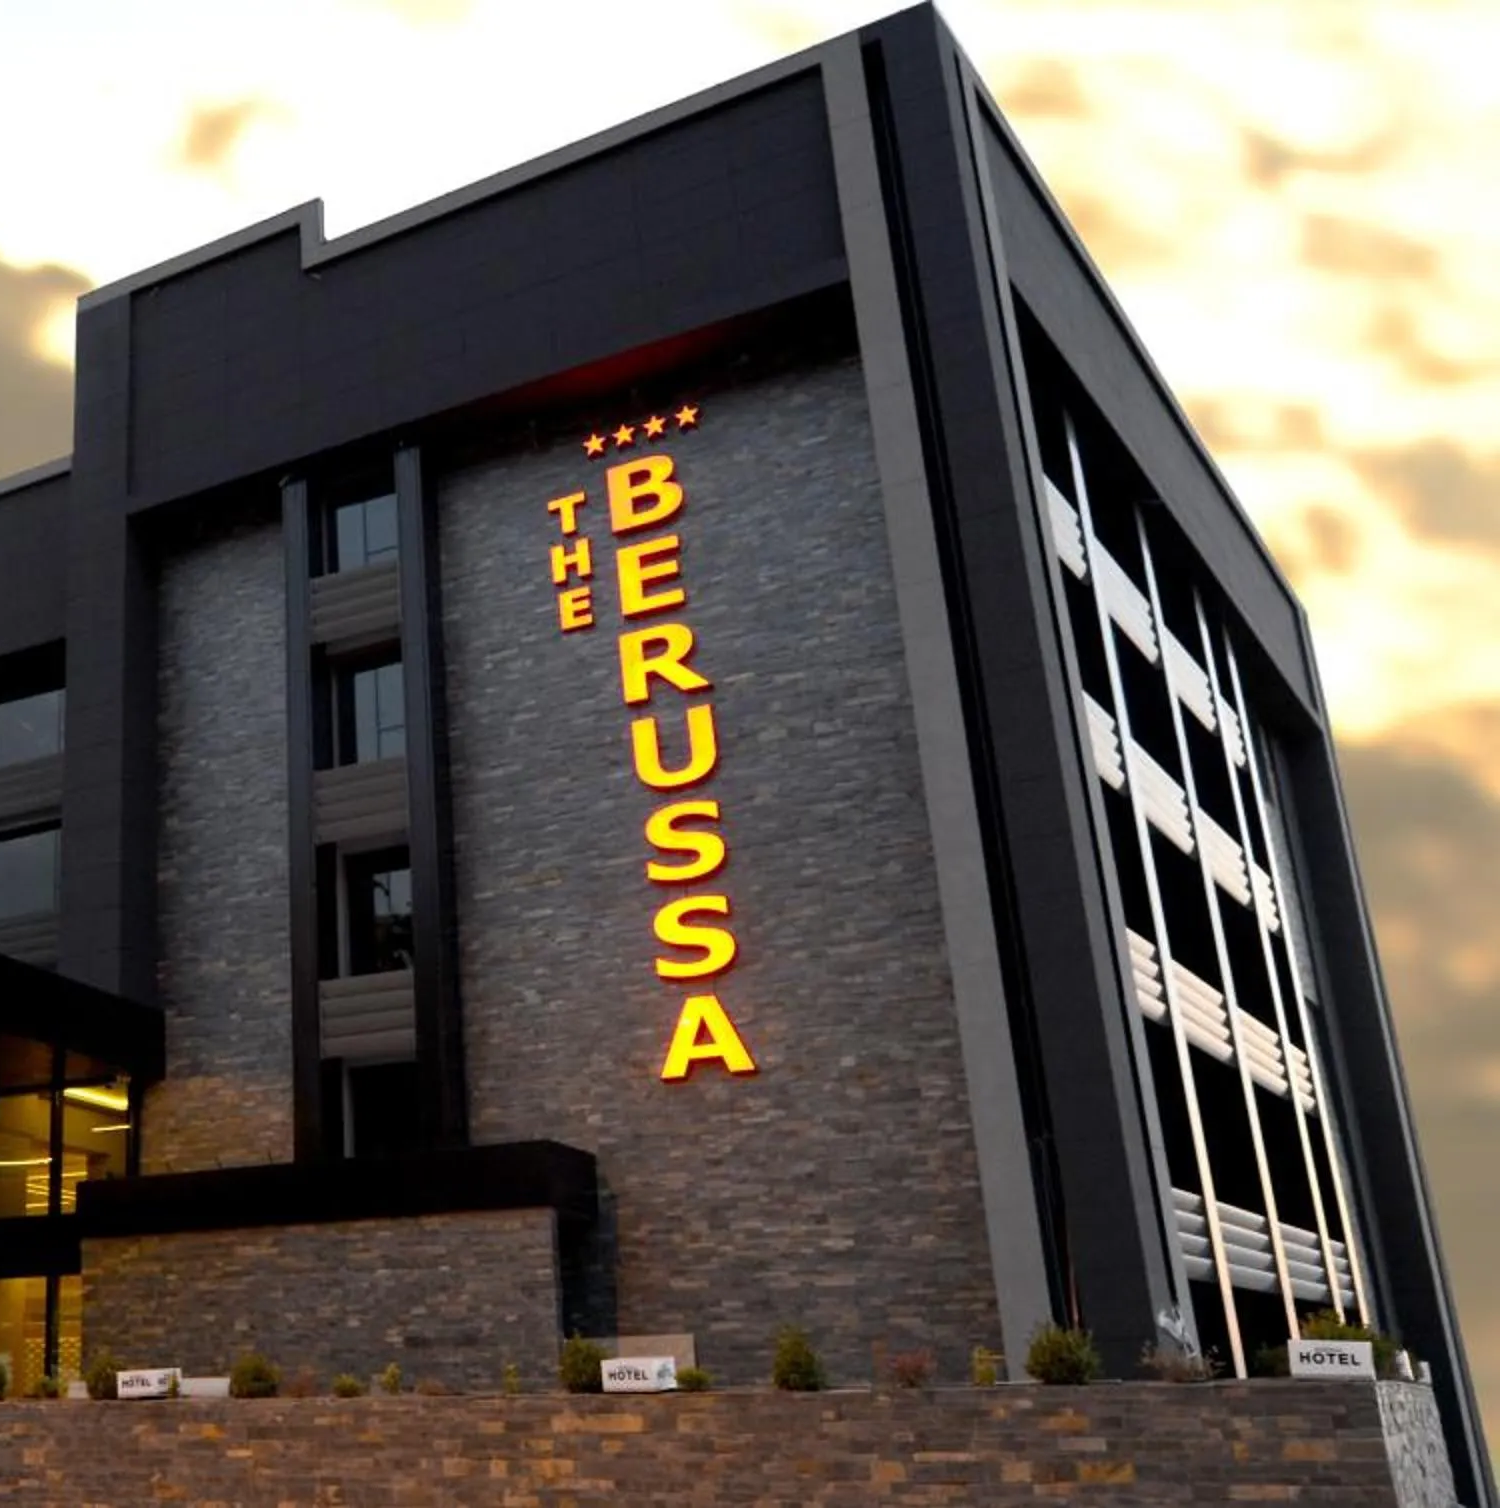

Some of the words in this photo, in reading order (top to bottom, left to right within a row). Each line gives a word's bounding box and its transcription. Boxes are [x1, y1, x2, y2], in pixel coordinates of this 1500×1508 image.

[547, 490, 595, 632] THE
[606, 453, 757, 1082] BERUSSA
[608, 1369, 649, 1381] HOTEL
[1299, 1352, 1361, 1366] HOTEL
